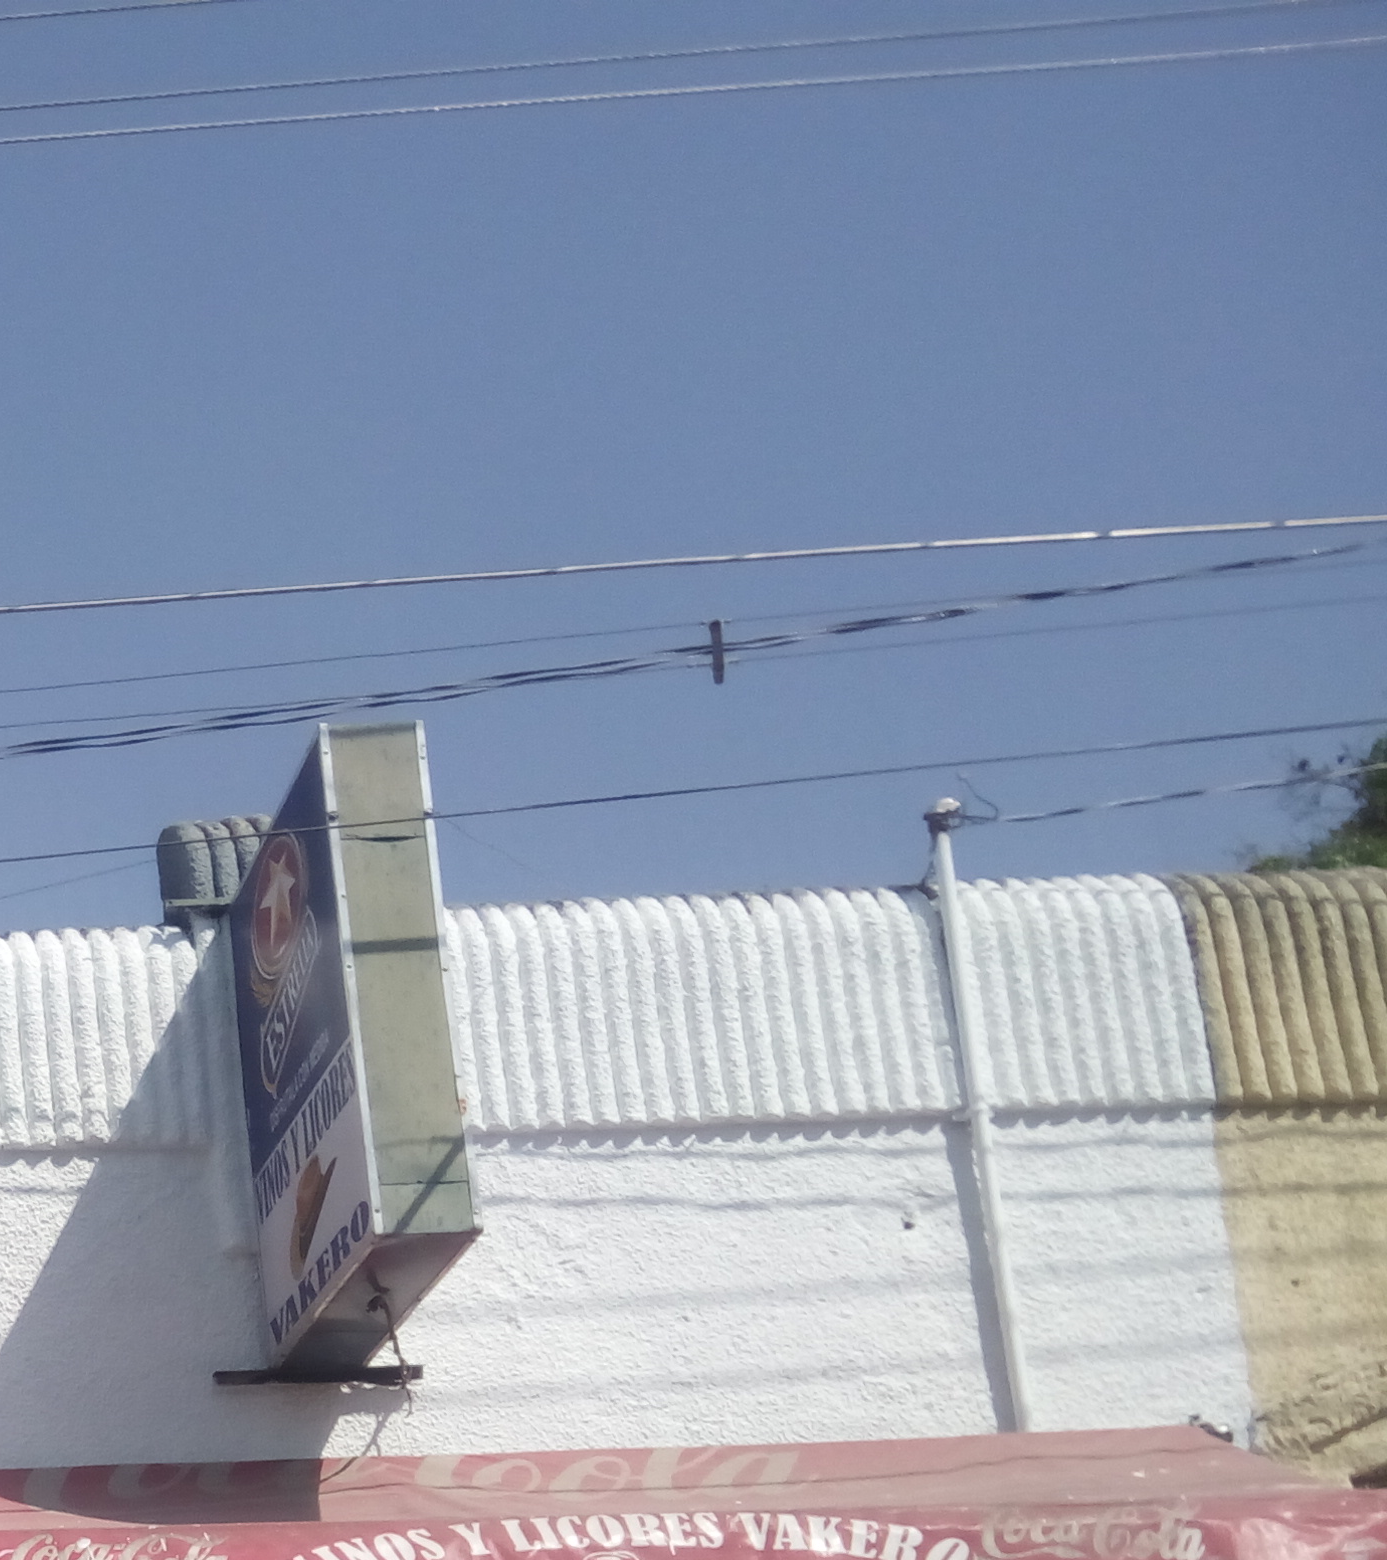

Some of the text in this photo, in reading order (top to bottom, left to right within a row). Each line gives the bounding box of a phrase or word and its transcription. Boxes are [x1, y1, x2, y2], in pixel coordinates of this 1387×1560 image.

[254, 1040, 357, 1225] VINOS Y LICORES
[270, 1201, 370, 1344] VAKERO
[448, 1521, 492, 1557] Y
[500, 1512, 724, 1552] LICORES
